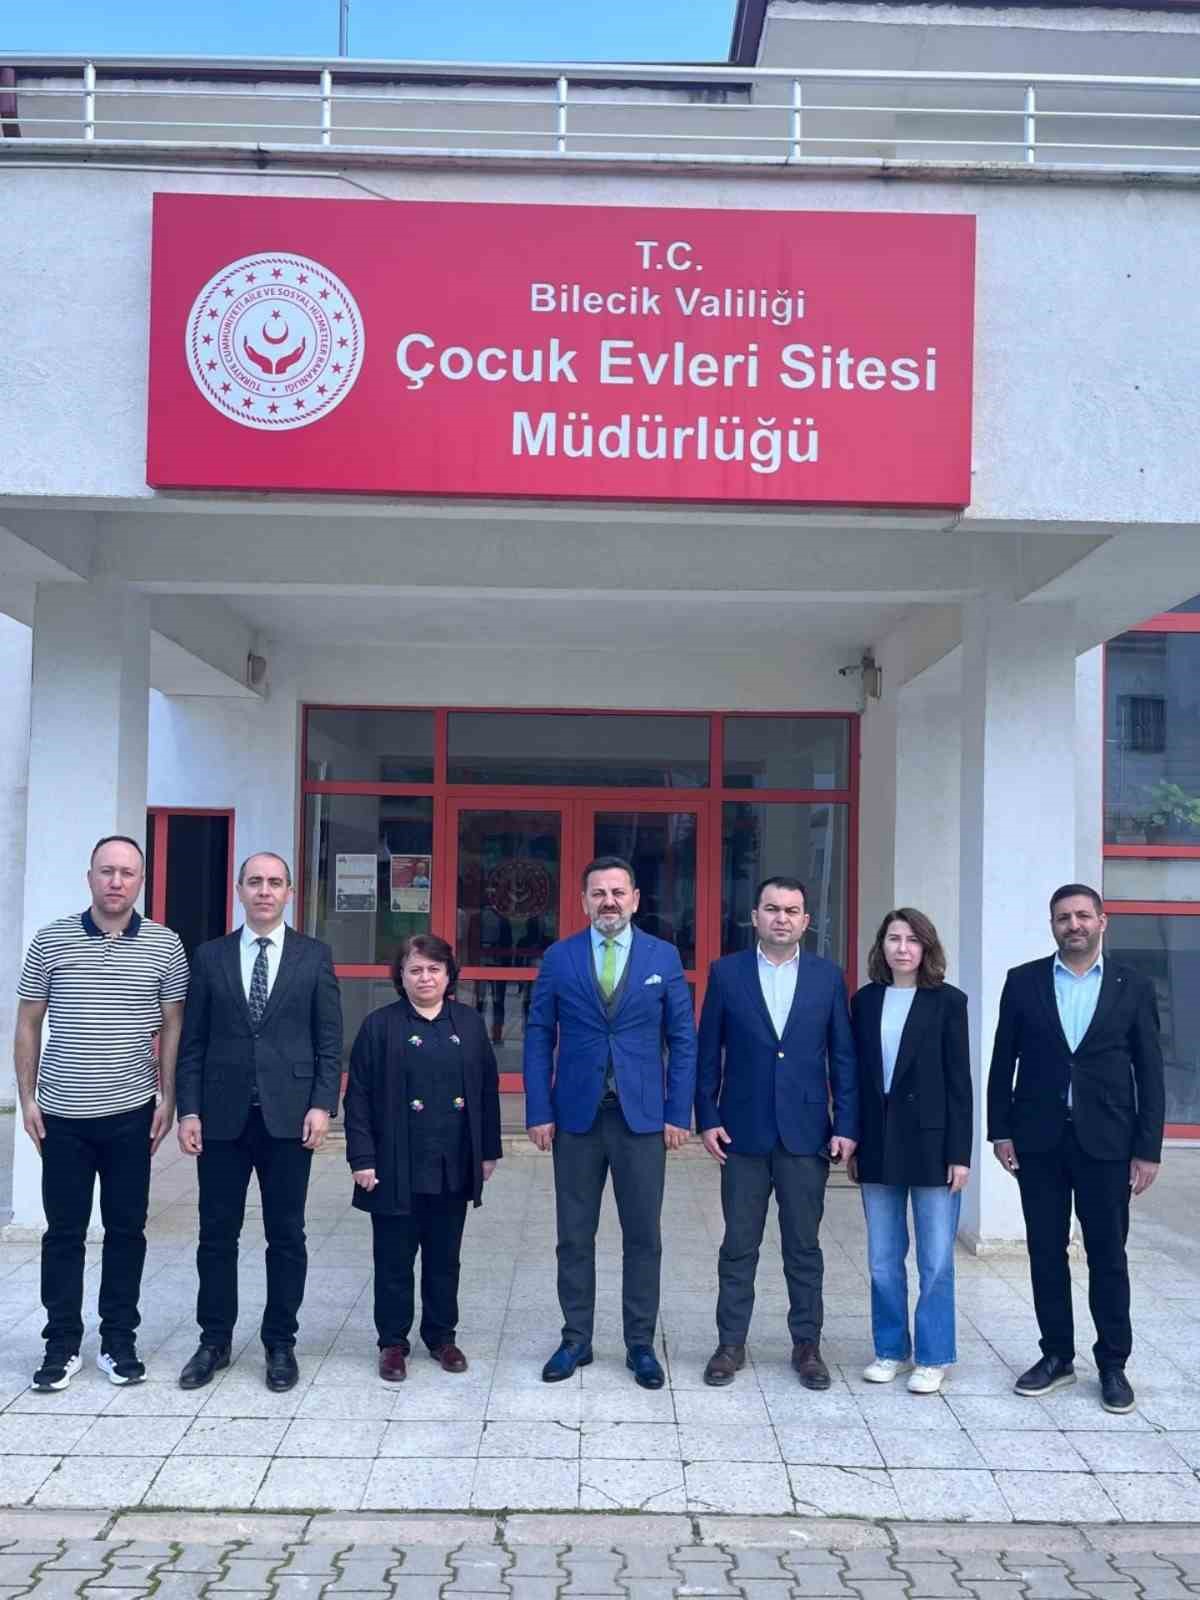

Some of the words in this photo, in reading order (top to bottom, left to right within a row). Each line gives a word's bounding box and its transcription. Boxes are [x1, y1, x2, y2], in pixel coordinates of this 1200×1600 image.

[635, 241, 703, 271] T.C.
[262, 287, 276, 296] VE
[277, 287, 311, 307] SOSYAL
[531, 283, 661, 315] Bilecik
[674, 287, 806, 326] Valiliği
[396, 333, 578, 390] Çocuk
[599, 339, 758, 388] Evleri
[779, 343, 936, 392] Sitesi
[512, 411, 819, 475] Müdürlüğü
